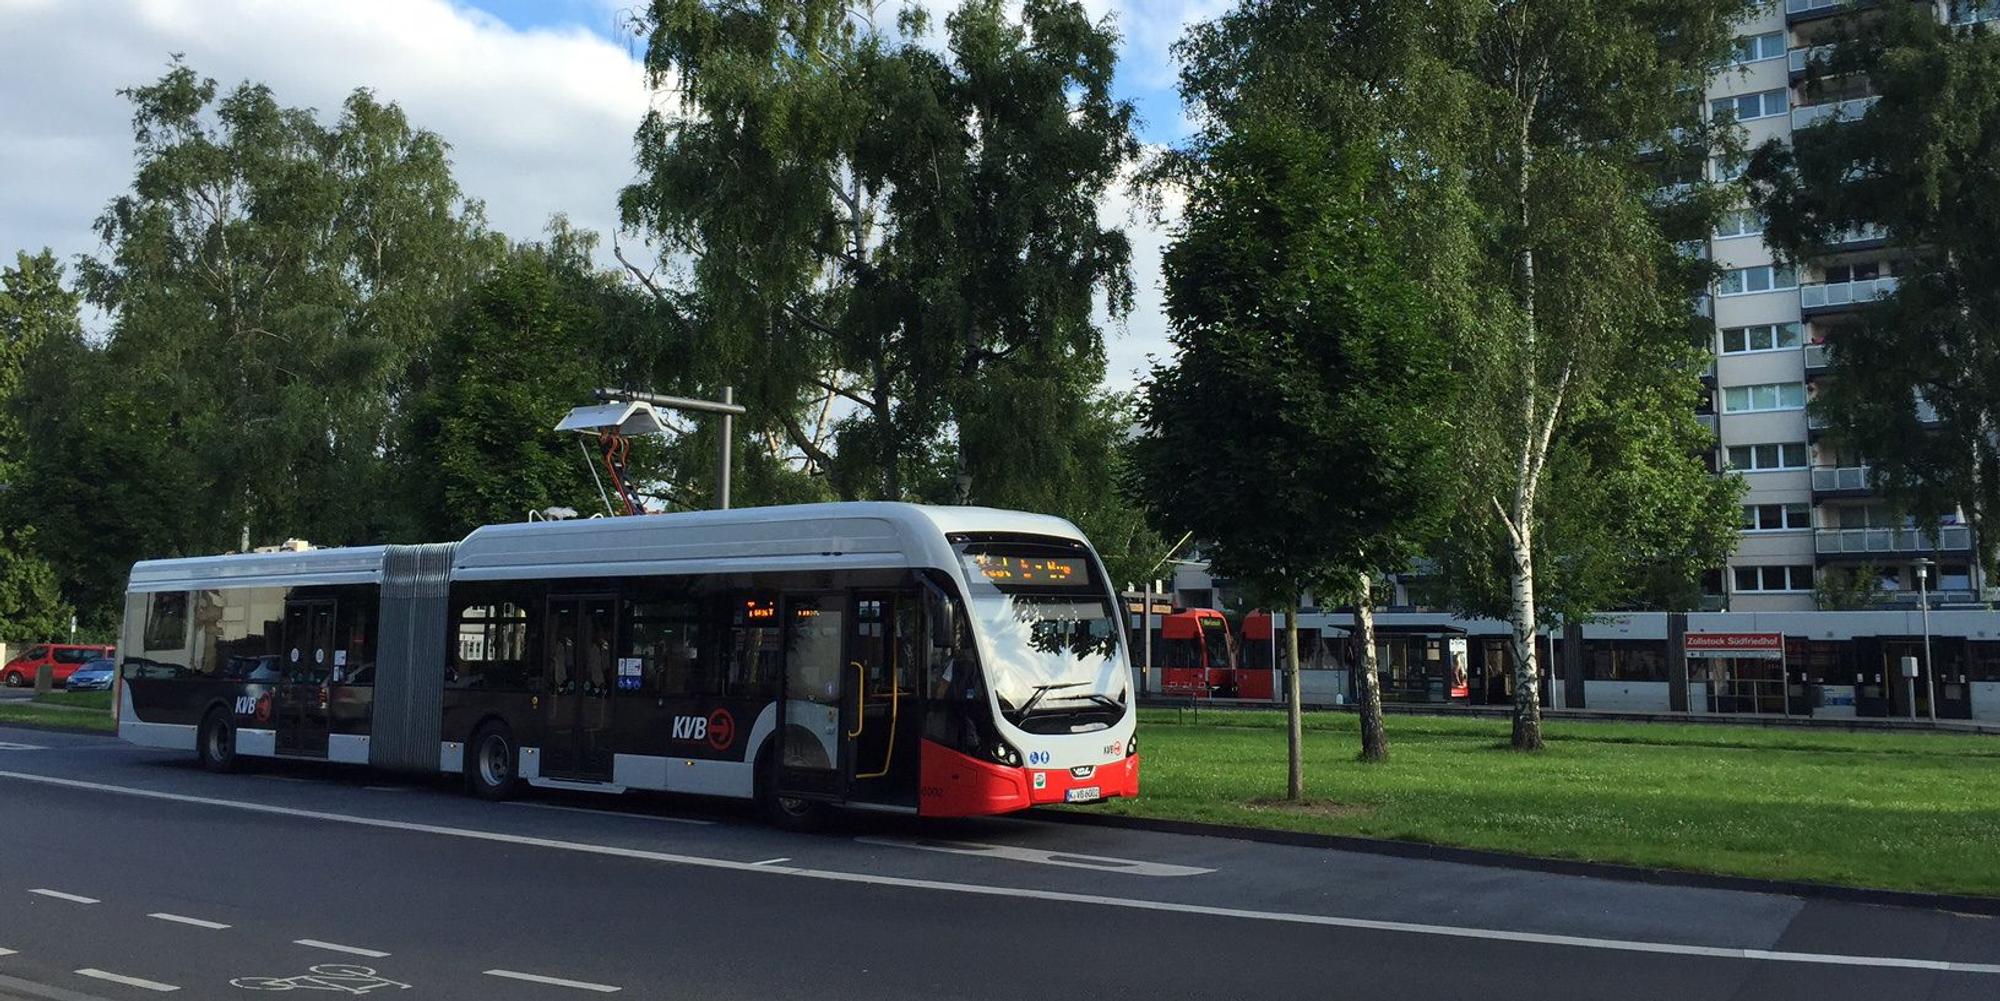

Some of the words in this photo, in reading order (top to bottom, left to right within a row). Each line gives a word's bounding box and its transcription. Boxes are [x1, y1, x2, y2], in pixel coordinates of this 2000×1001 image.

[1687, 637, 1725, 645] Zollstock
[1727, 637, 1778, 645] Südfriedhof
[235, 696, 257, 714] KVB
[672, 716, 708, 739] KVB
